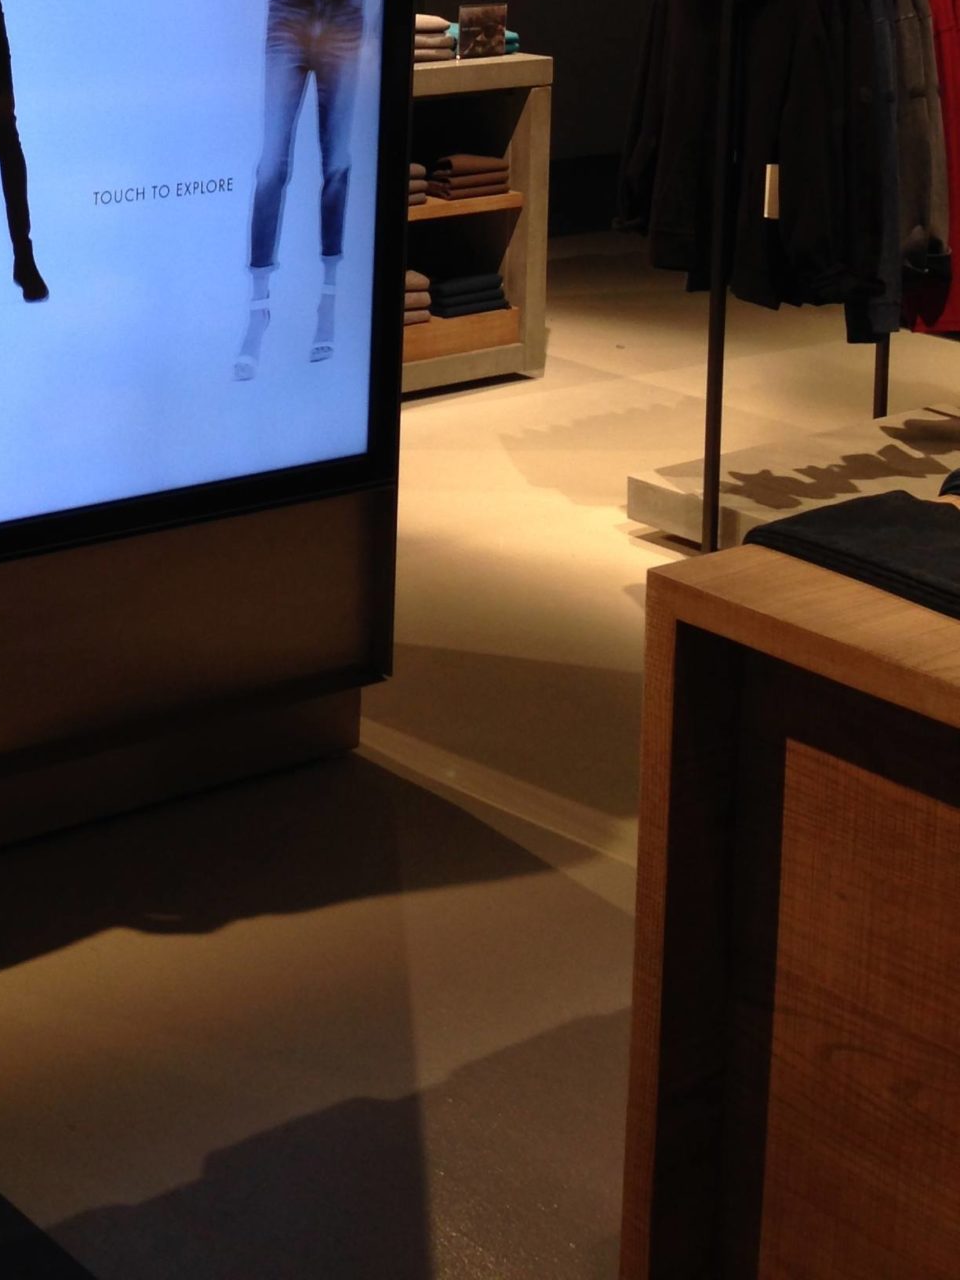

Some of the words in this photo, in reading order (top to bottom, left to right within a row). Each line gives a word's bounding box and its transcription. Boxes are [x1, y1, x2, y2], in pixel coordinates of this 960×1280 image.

[93, 186, 145, 206] TOUCH
[152, 184, 170, 200] TO
[176, 177, 234, 197] EXPLORE
